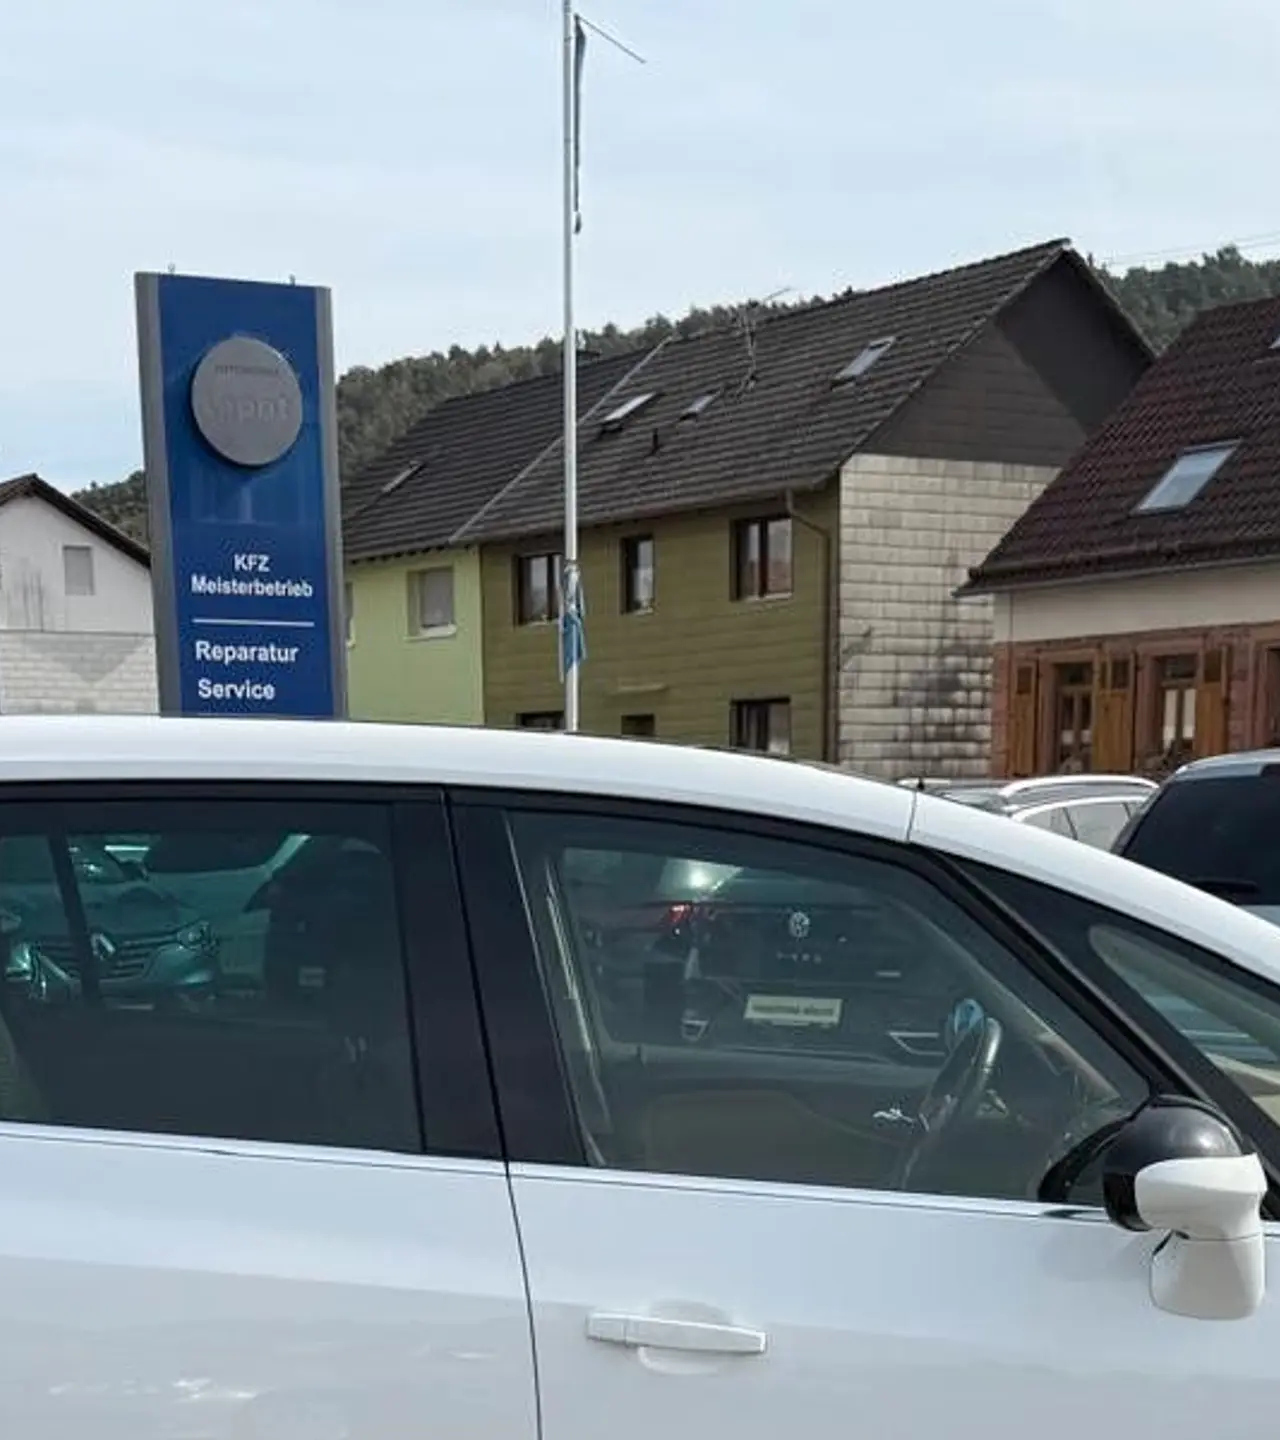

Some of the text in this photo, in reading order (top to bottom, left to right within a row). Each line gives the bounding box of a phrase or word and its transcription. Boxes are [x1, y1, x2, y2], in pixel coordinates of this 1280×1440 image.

[233, 553, 271, 573] KFZ
[191, 573, 313, 597] Meisterbetrieb
[195, 640, 299, 666] Reparatur
[198, 677, 276, 700] Service
